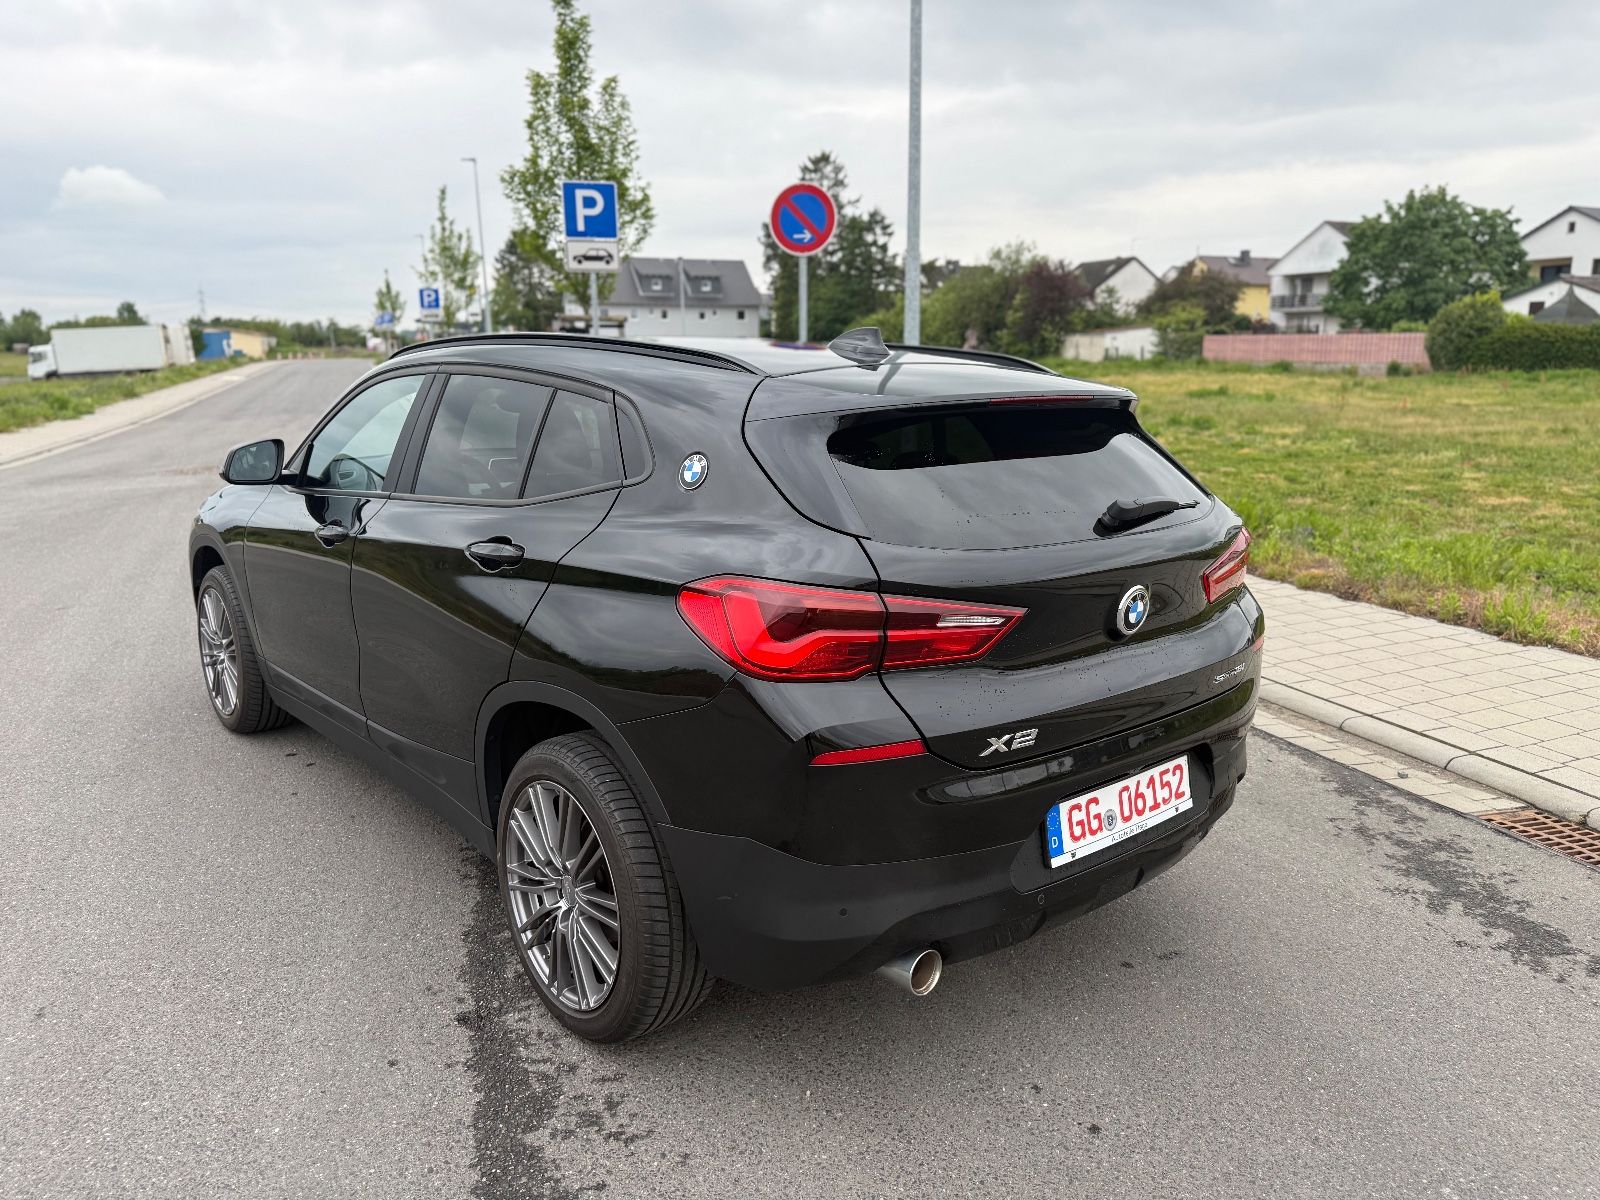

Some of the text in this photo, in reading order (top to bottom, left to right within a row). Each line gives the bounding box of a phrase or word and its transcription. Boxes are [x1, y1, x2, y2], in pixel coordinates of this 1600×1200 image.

[575, 188, 605, 232] P
[979, 728, 1039, 757] X2
[1051, 836, 1059, 849] D
[1067, 796, 1104, 844] GG
[1118, 763, 1186, 824] 06152
